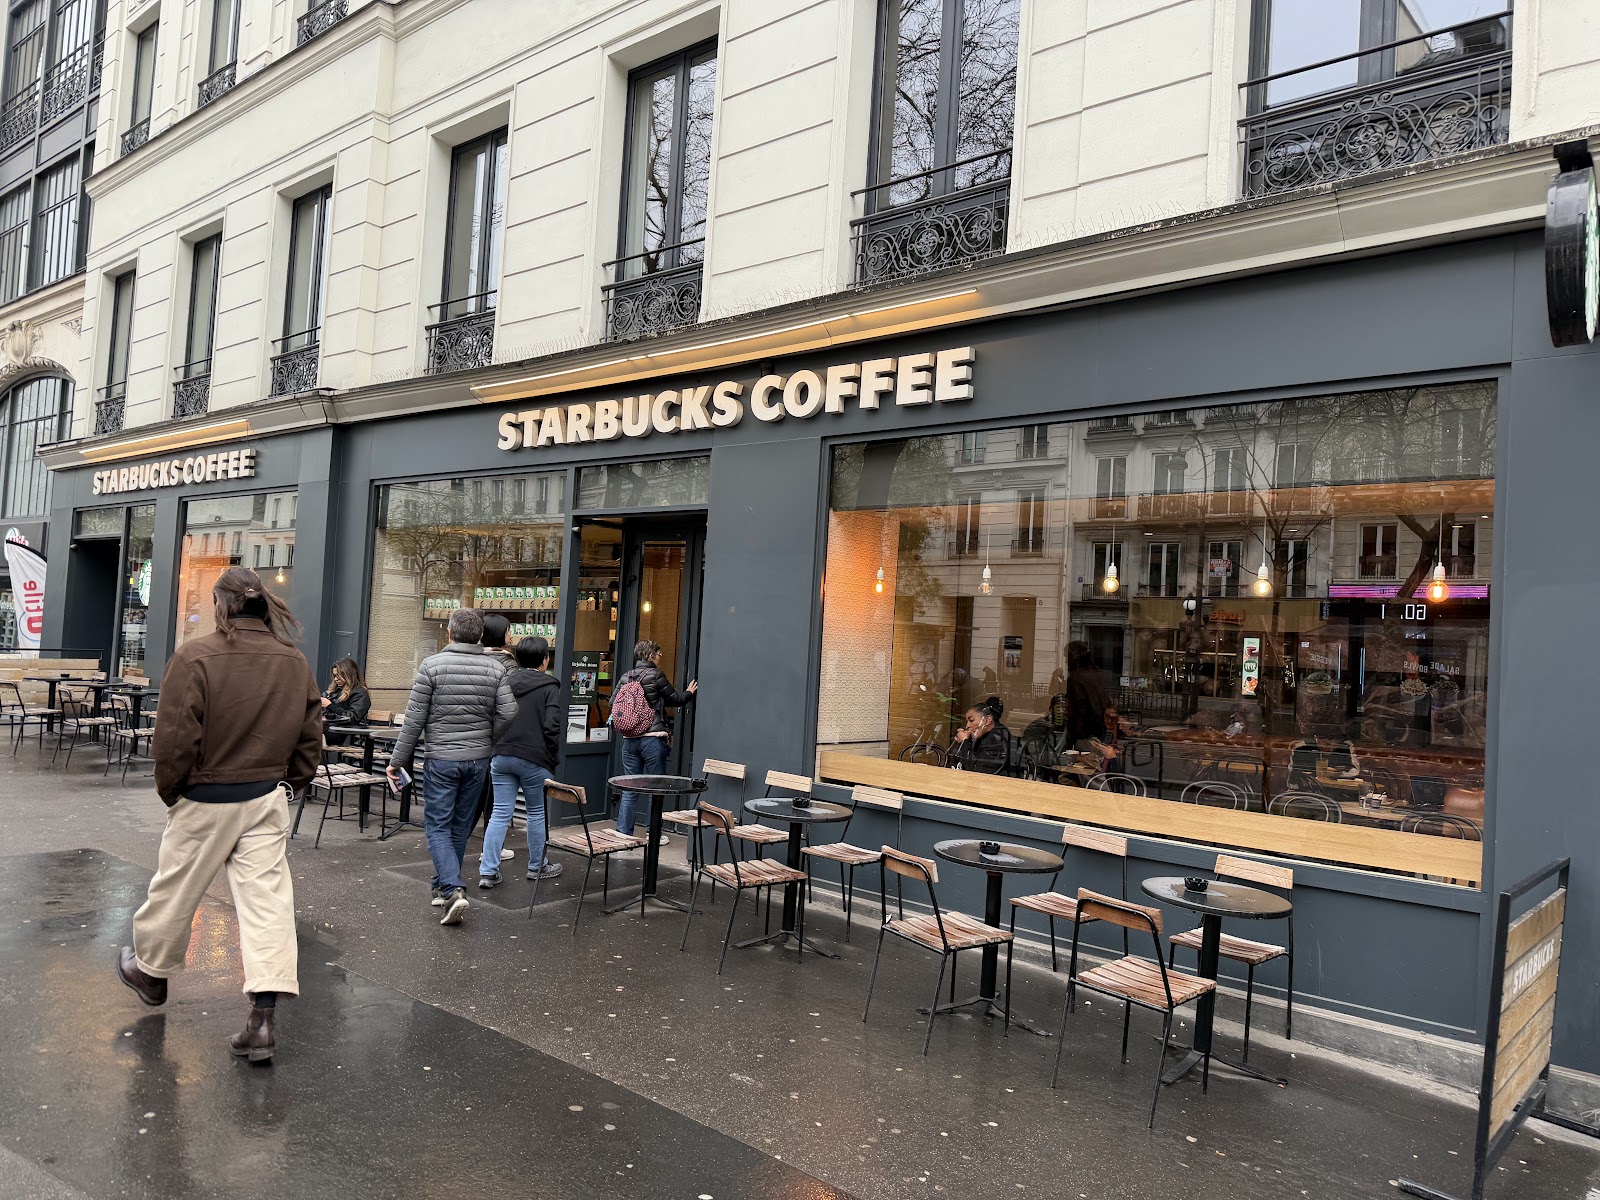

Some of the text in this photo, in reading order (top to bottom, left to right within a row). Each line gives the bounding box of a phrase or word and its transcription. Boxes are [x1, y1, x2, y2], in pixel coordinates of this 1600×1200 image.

[498, 346, 976, 451] STARBUCKS COFFEE
[92, 449, 255, 495] STARBUCKS COFFEE
[1512, 938, 1555, 994] STARBUCKS
